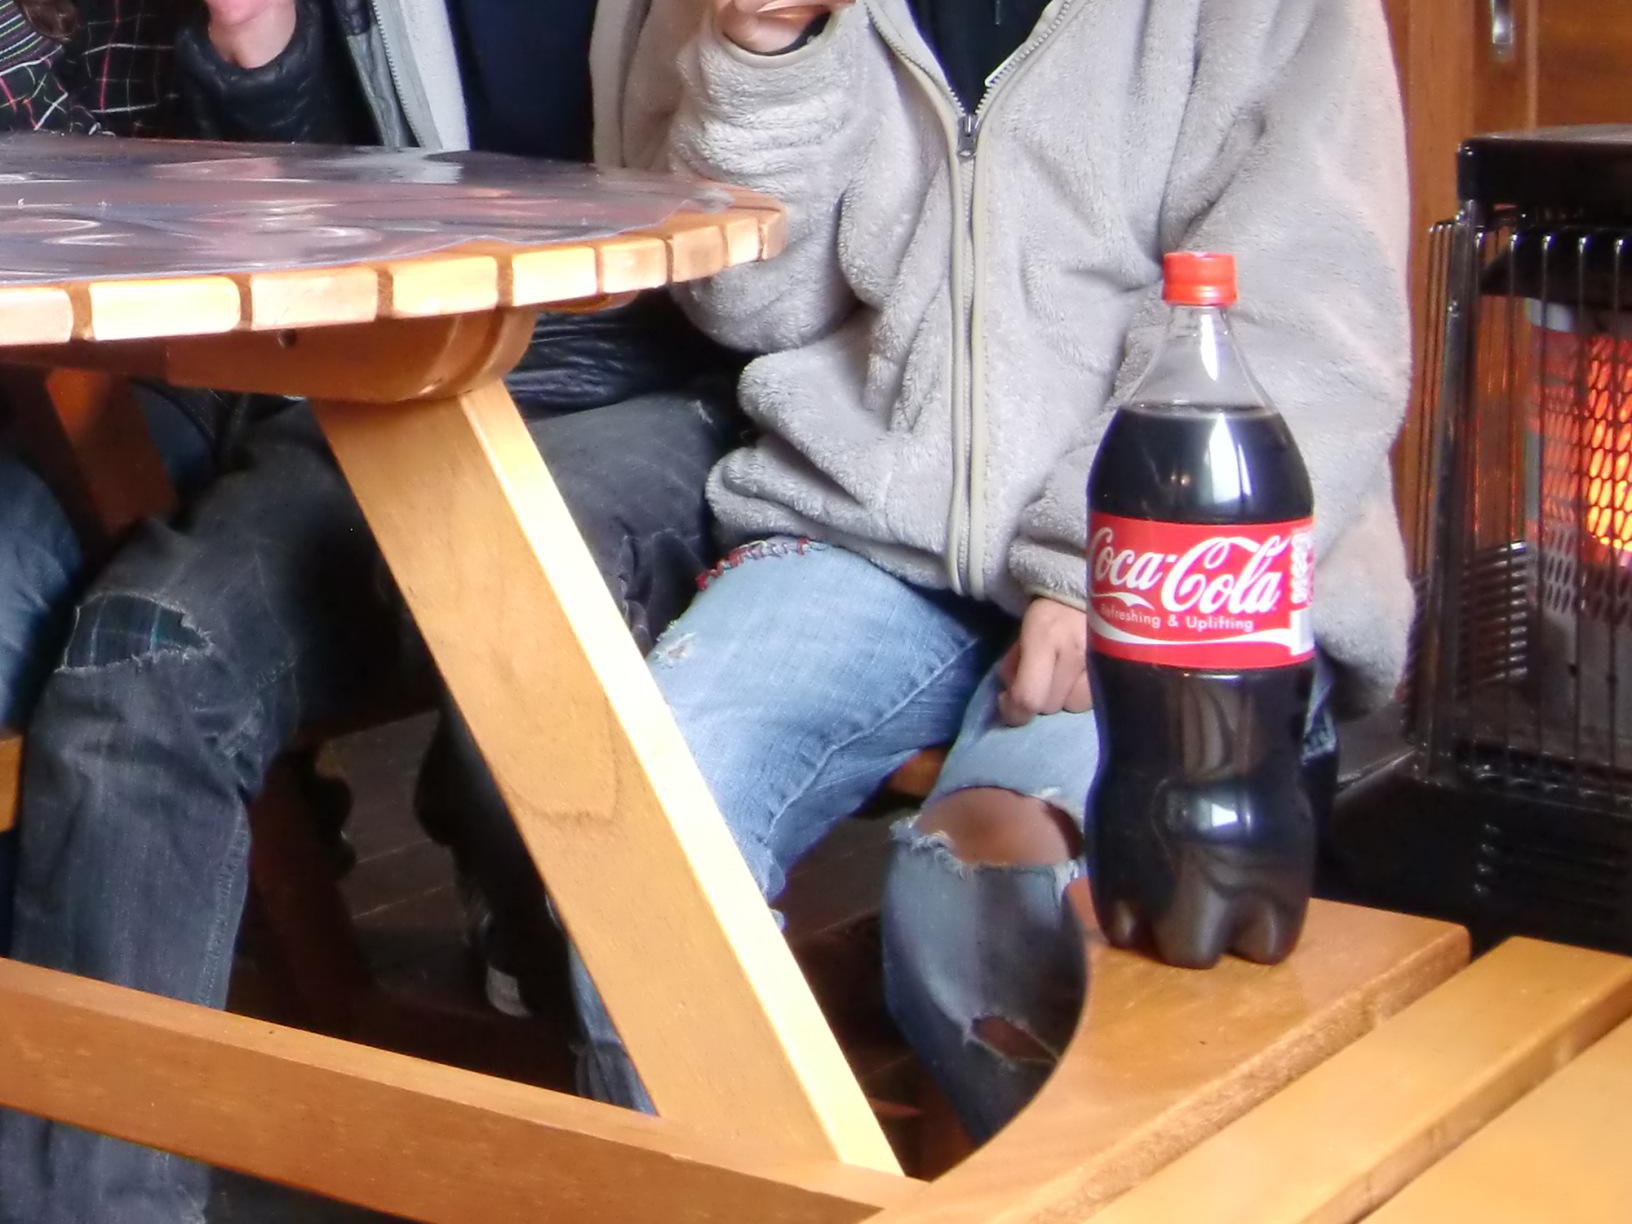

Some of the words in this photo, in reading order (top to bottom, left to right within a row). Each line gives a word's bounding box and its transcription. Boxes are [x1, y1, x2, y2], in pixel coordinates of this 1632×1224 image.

[1089, 526, 1291, 614] Coca-Cola
[1101, 602, 1162, 629] Refreshing
[1167, 616, 1179, 628] &
[1186, 616, 1255, 633] Uplifting
